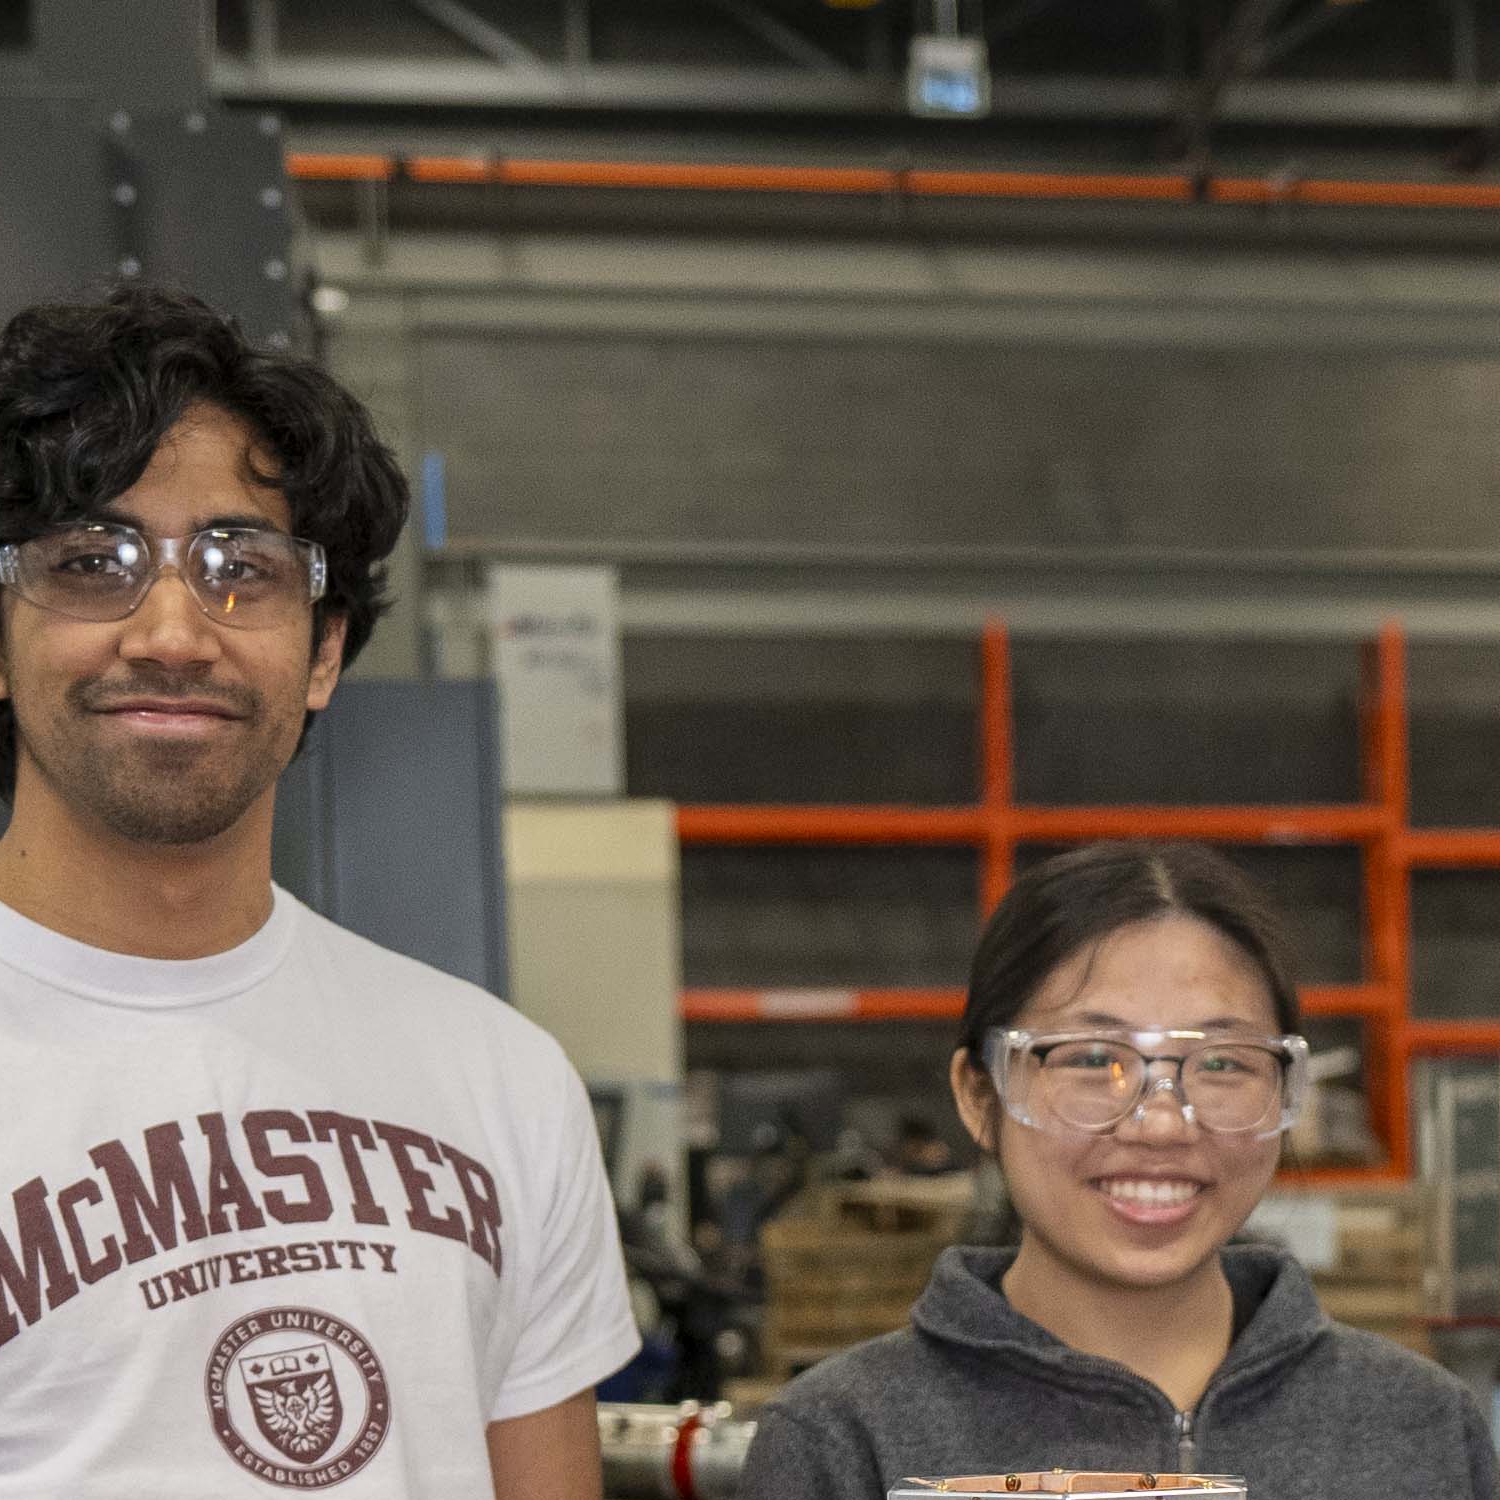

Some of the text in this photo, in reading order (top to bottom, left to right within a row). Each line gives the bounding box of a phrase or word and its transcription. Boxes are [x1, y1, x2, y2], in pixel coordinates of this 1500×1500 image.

[139, 1238, 397, 1310] UNIVERSITY
[270, 1313, 381, 1382] UNIVERSITY
[233, 1421, 382, 1485] ESTABLISHED 1887
